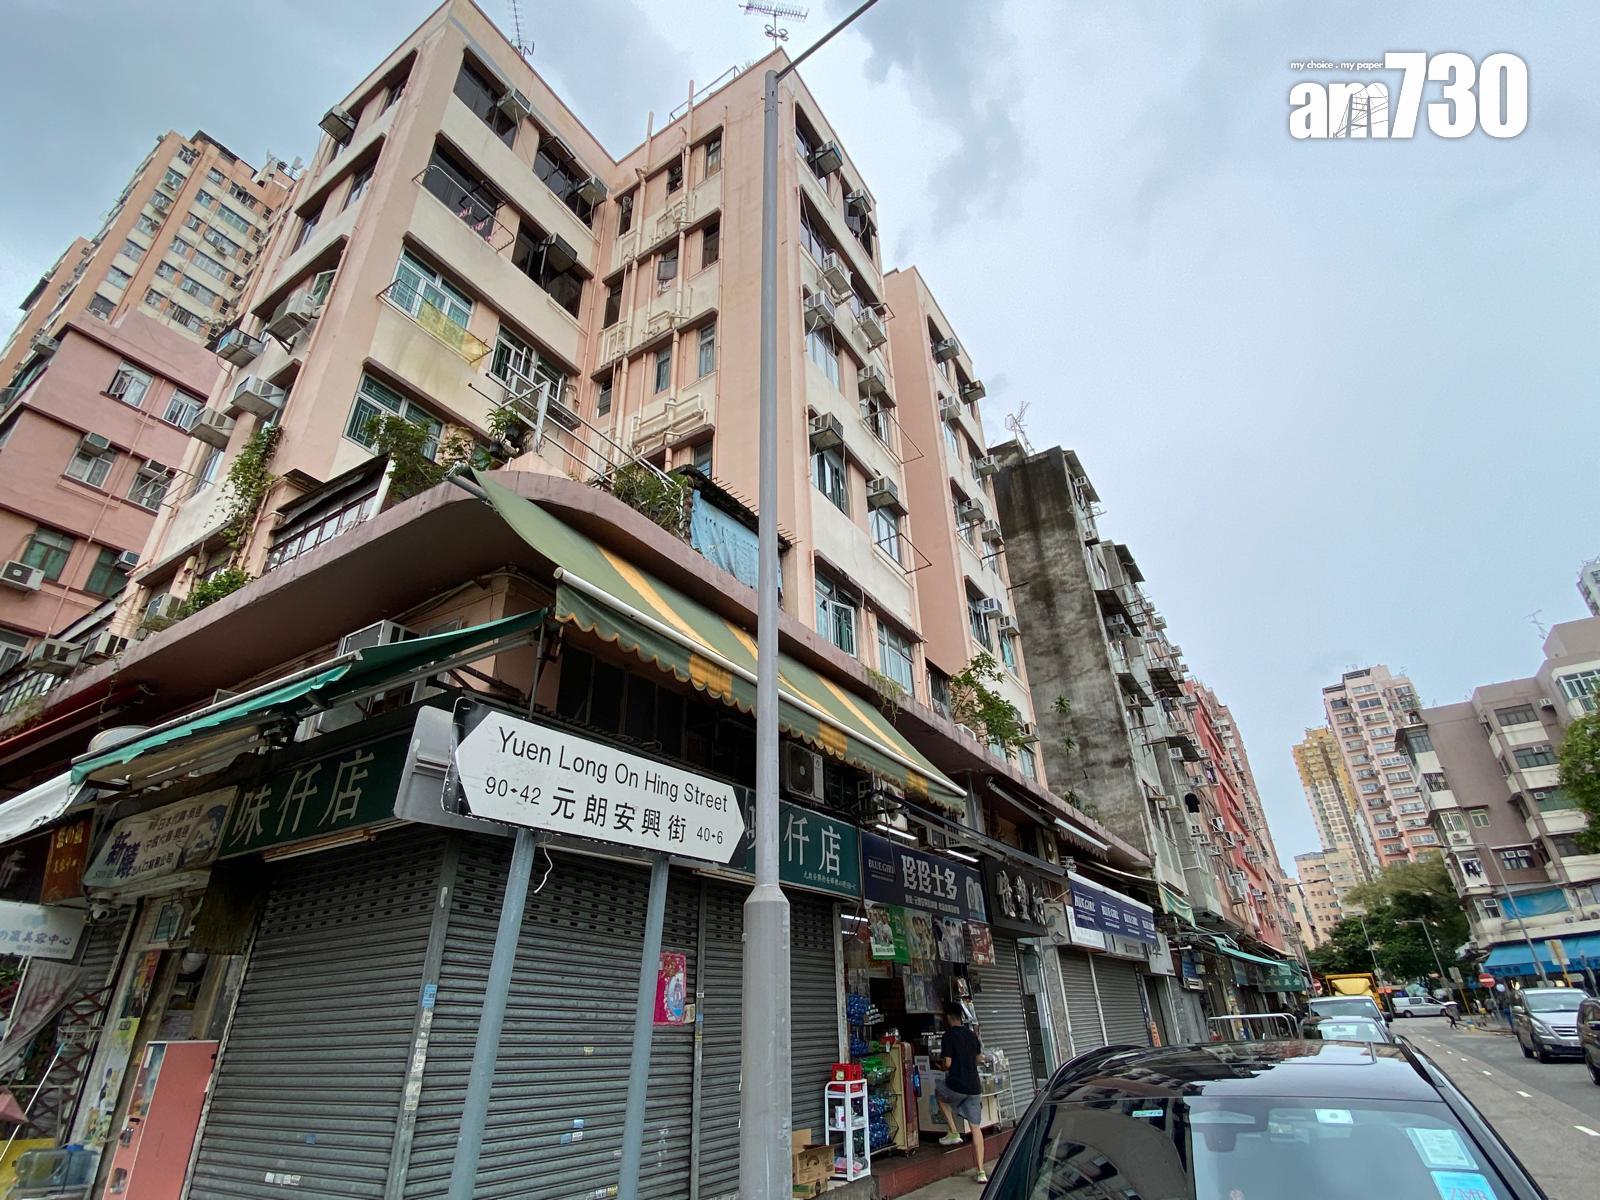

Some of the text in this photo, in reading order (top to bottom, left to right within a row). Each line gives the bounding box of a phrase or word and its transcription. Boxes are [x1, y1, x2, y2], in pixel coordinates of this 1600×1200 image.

[499, 726, 728, 812] Yuen Long On Hing Street
[551, 786, 686, 843] 元朗安興街
